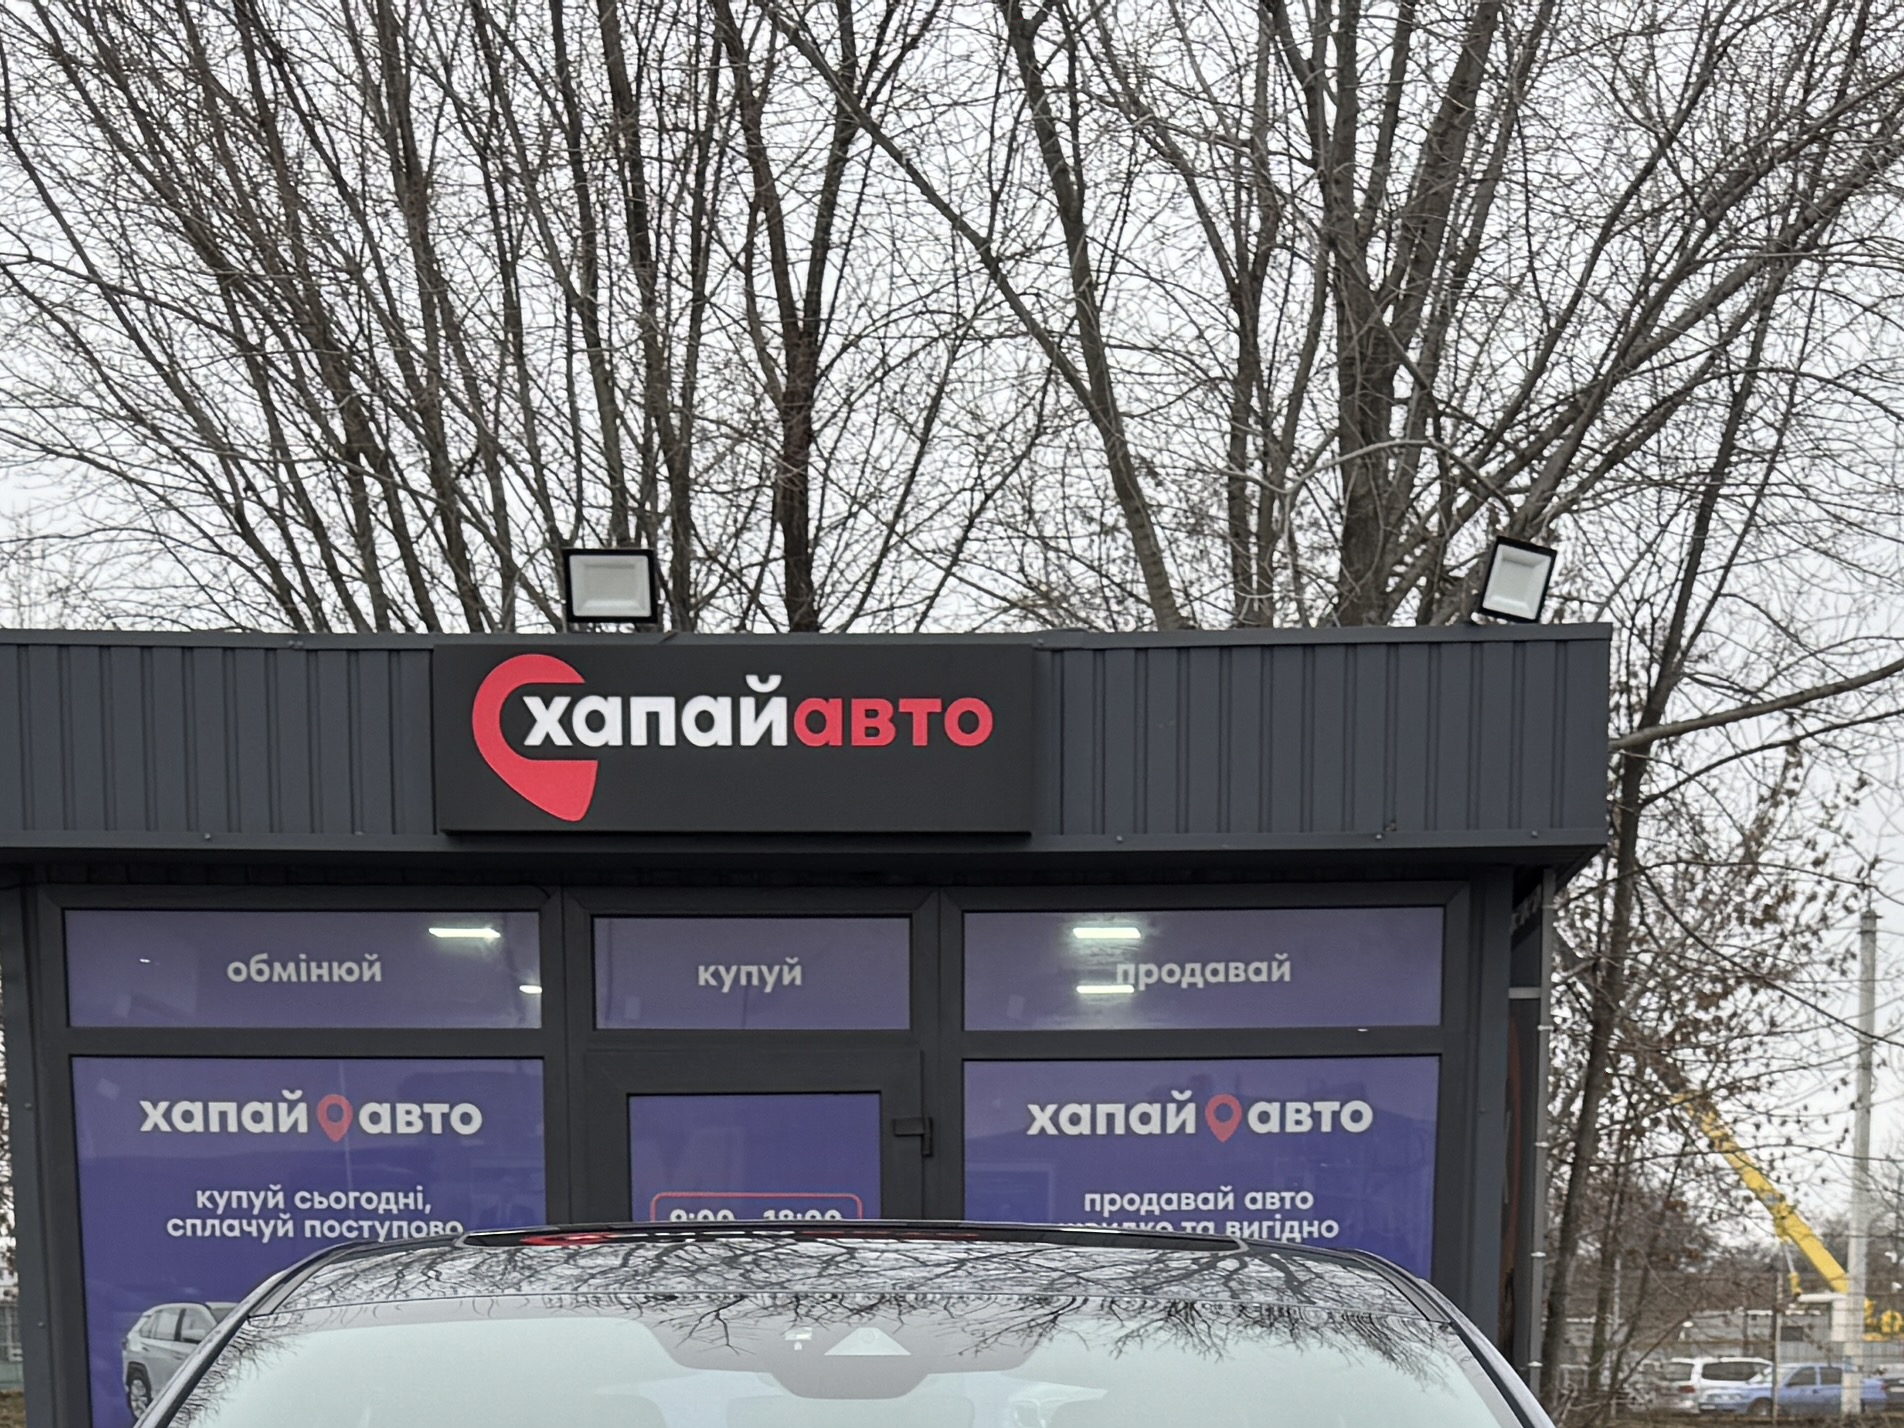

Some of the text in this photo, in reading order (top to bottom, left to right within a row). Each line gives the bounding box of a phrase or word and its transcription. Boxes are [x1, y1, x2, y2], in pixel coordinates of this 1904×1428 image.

[226, 953, 383, 983] обмінюй
[698, 957, 803, 993] купуй
[1116, 953, 1292, 990] продавай
[139, 1090, 483, 1135] хапай авто
[1026, 1090, 1374, 1135] хапай авто
[196, 1184, 432, 1215] купуй сьогодні,
[1084, 1185, 1314, 1217] продавай авто
[166, 1212, 294, 1243] сплачуй
[1225, 1213, 1339, 1243] вигідно
